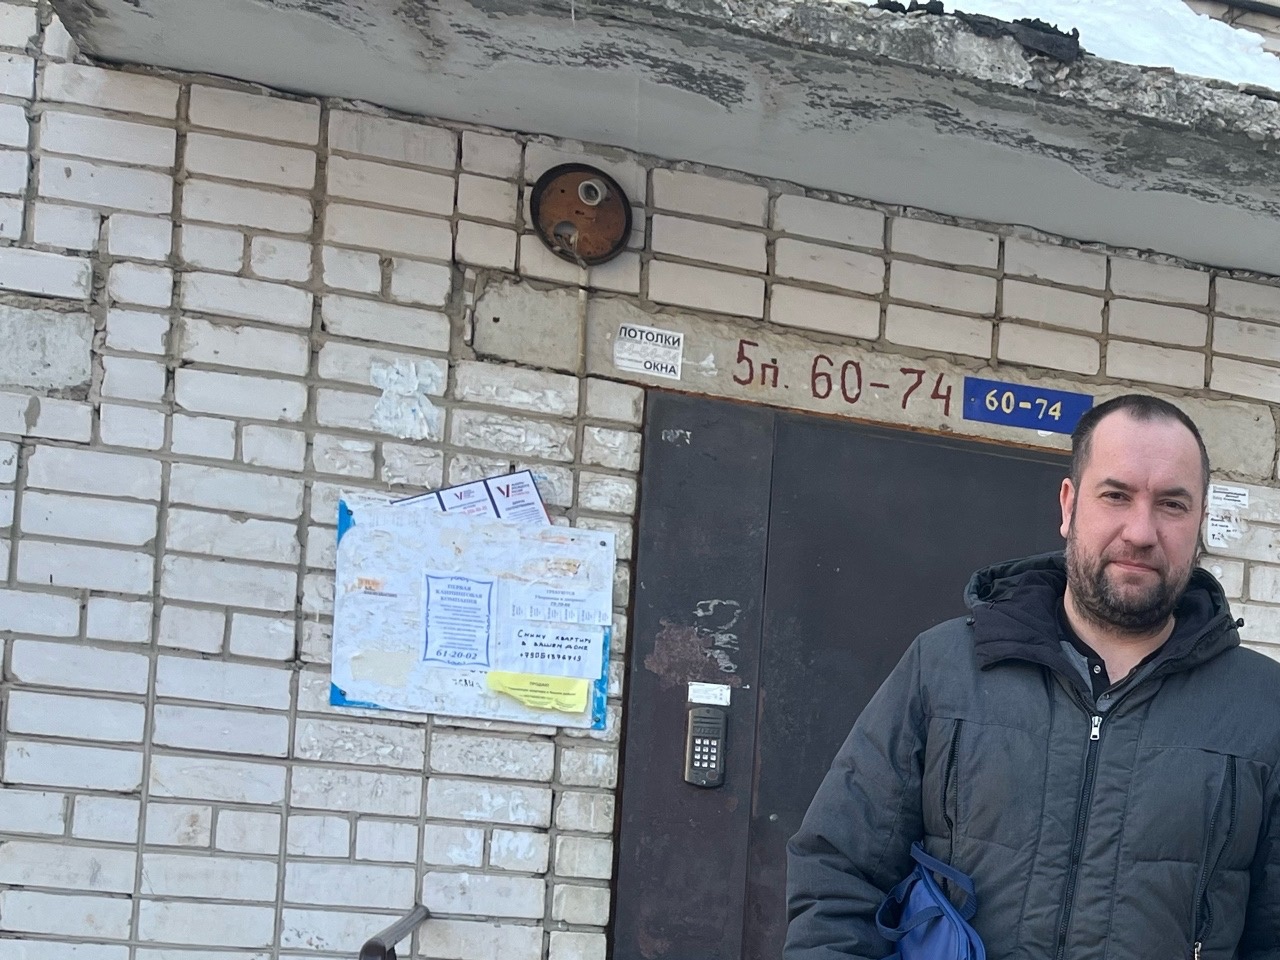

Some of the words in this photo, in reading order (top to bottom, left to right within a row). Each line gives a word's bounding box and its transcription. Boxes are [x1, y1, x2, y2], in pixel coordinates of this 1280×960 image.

[619, 326, 681, 347] ПОТОЛКИ
[644, 361, 677, 375] ОКНА
[811, 354, 953, 417] 60-74
[984, 388, 1062, 421] 60-74
[436, 649, 478, 660] 61-20-02
